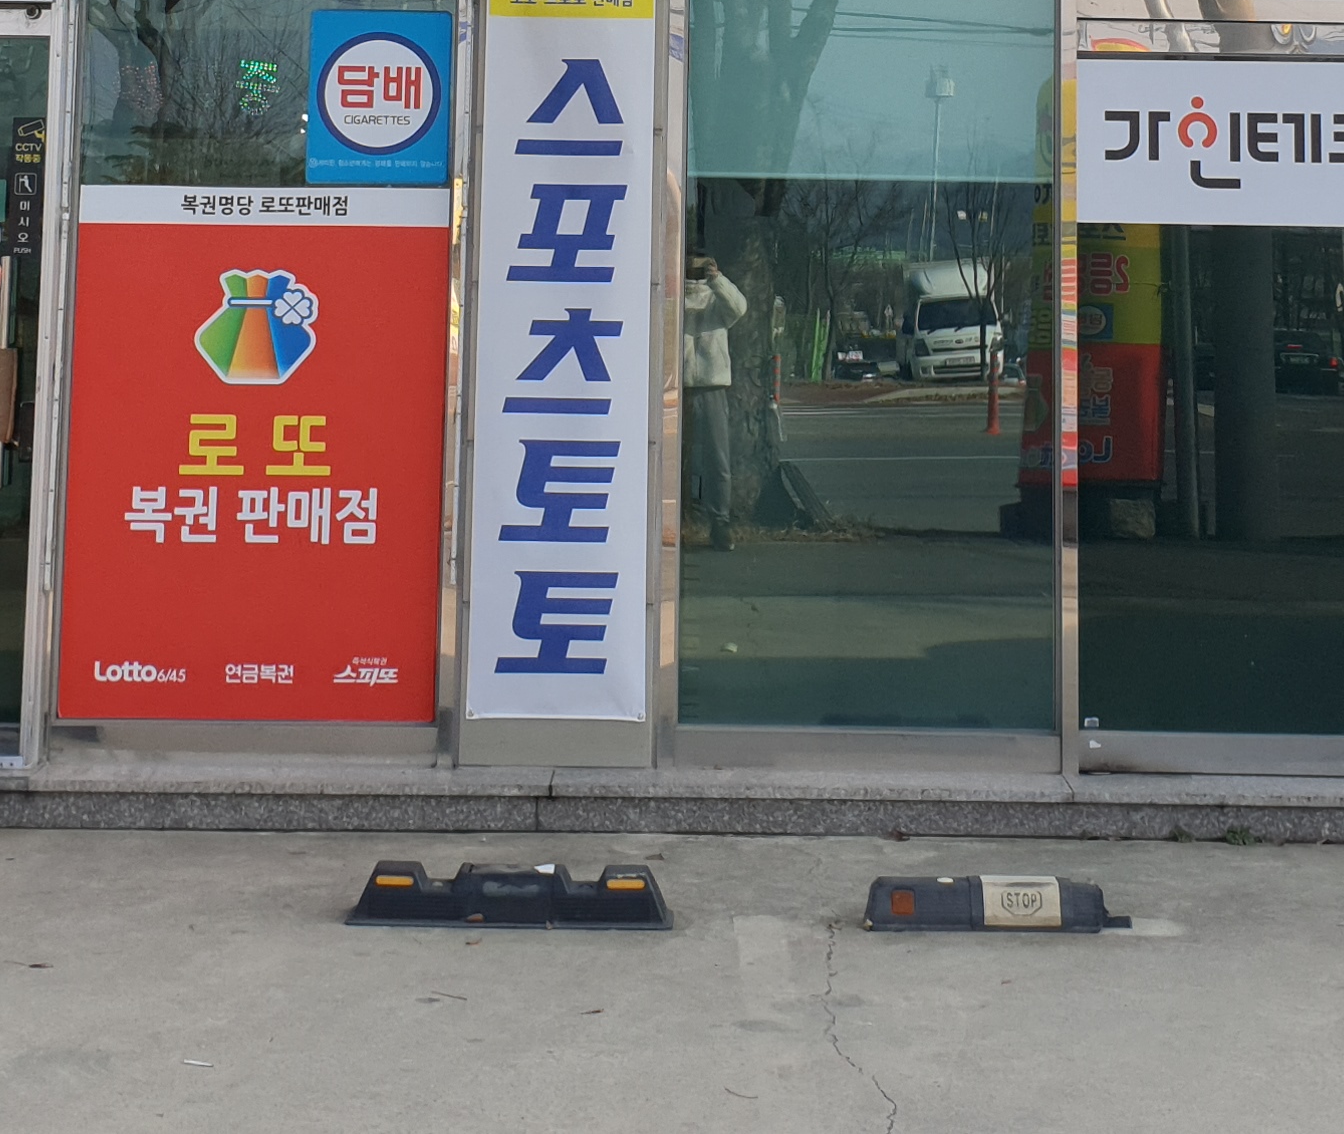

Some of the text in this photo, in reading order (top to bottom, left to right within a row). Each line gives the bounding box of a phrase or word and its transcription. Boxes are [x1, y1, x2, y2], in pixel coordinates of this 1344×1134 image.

[337, 65, 422, 110] 담배
[344, 115, 411, 126] CIGARETTES
[15, 143, 42, 152] CCTV
[181, 194, 349, 218] 복권명당 로또판매점
[494, 58, 628, 674] 스포츠토토
[124, 486, 379, 545] 복권 판매점
[225, 663, 294, 685] 연금복권
[333, 666, 398, 687] 스피또
[1006, 893, 1037, 909] STOP
